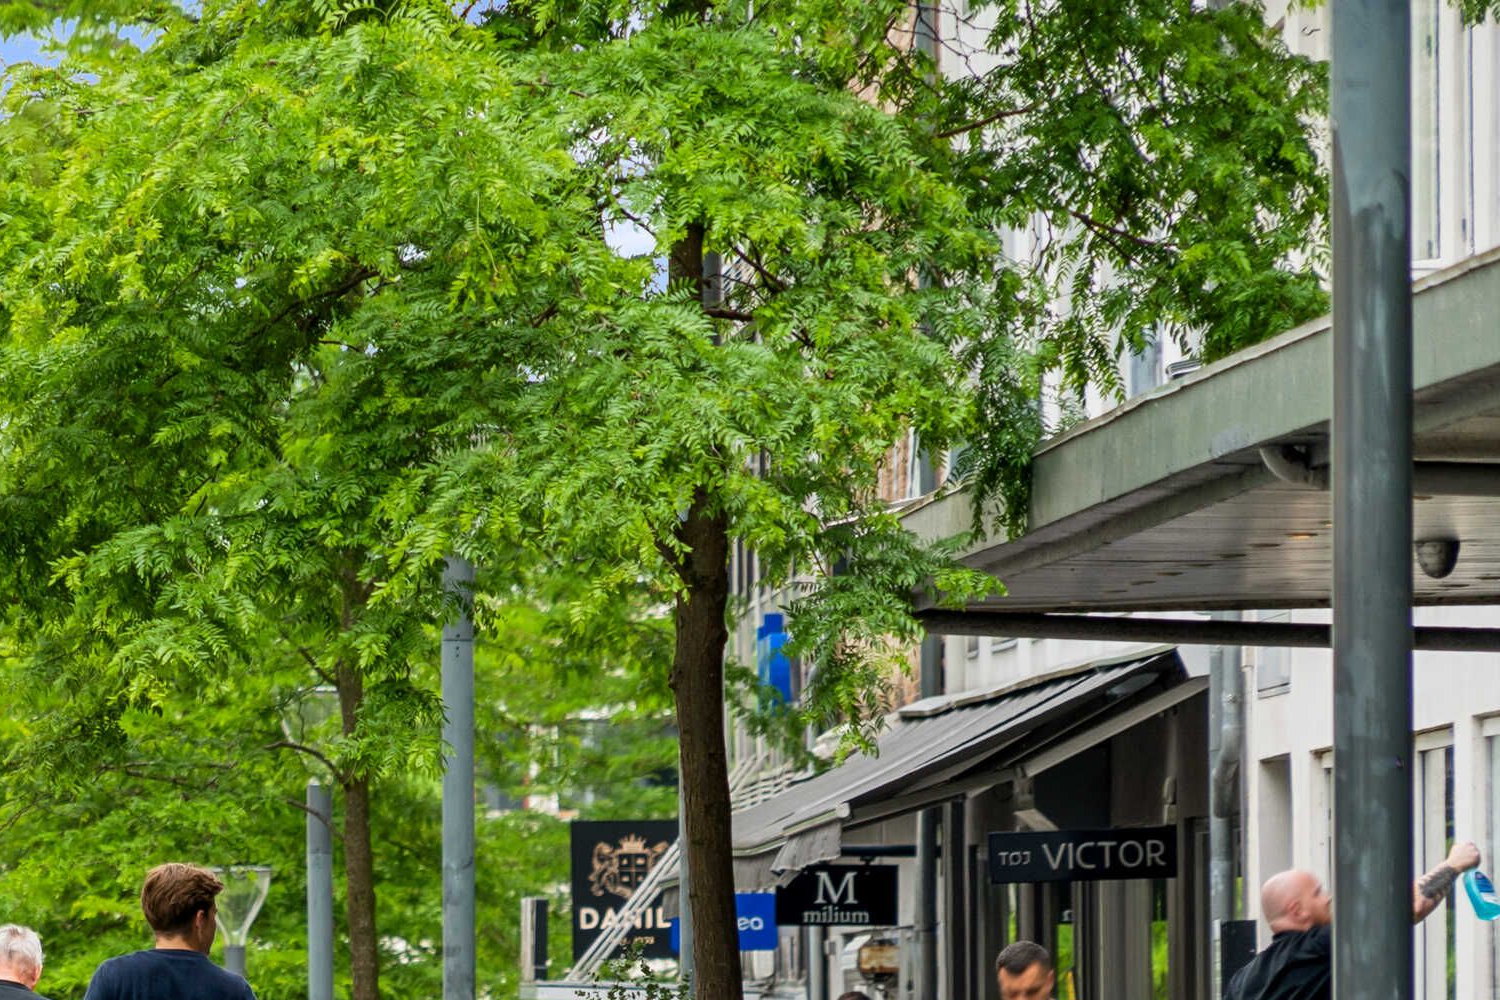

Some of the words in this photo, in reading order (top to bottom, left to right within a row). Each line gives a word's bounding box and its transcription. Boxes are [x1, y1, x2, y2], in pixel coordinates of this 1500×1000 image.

[1042, 840, 1167, 871] VICTOR
[813, 871, 858, 904] M
[802, 905, 870, 923] milium
